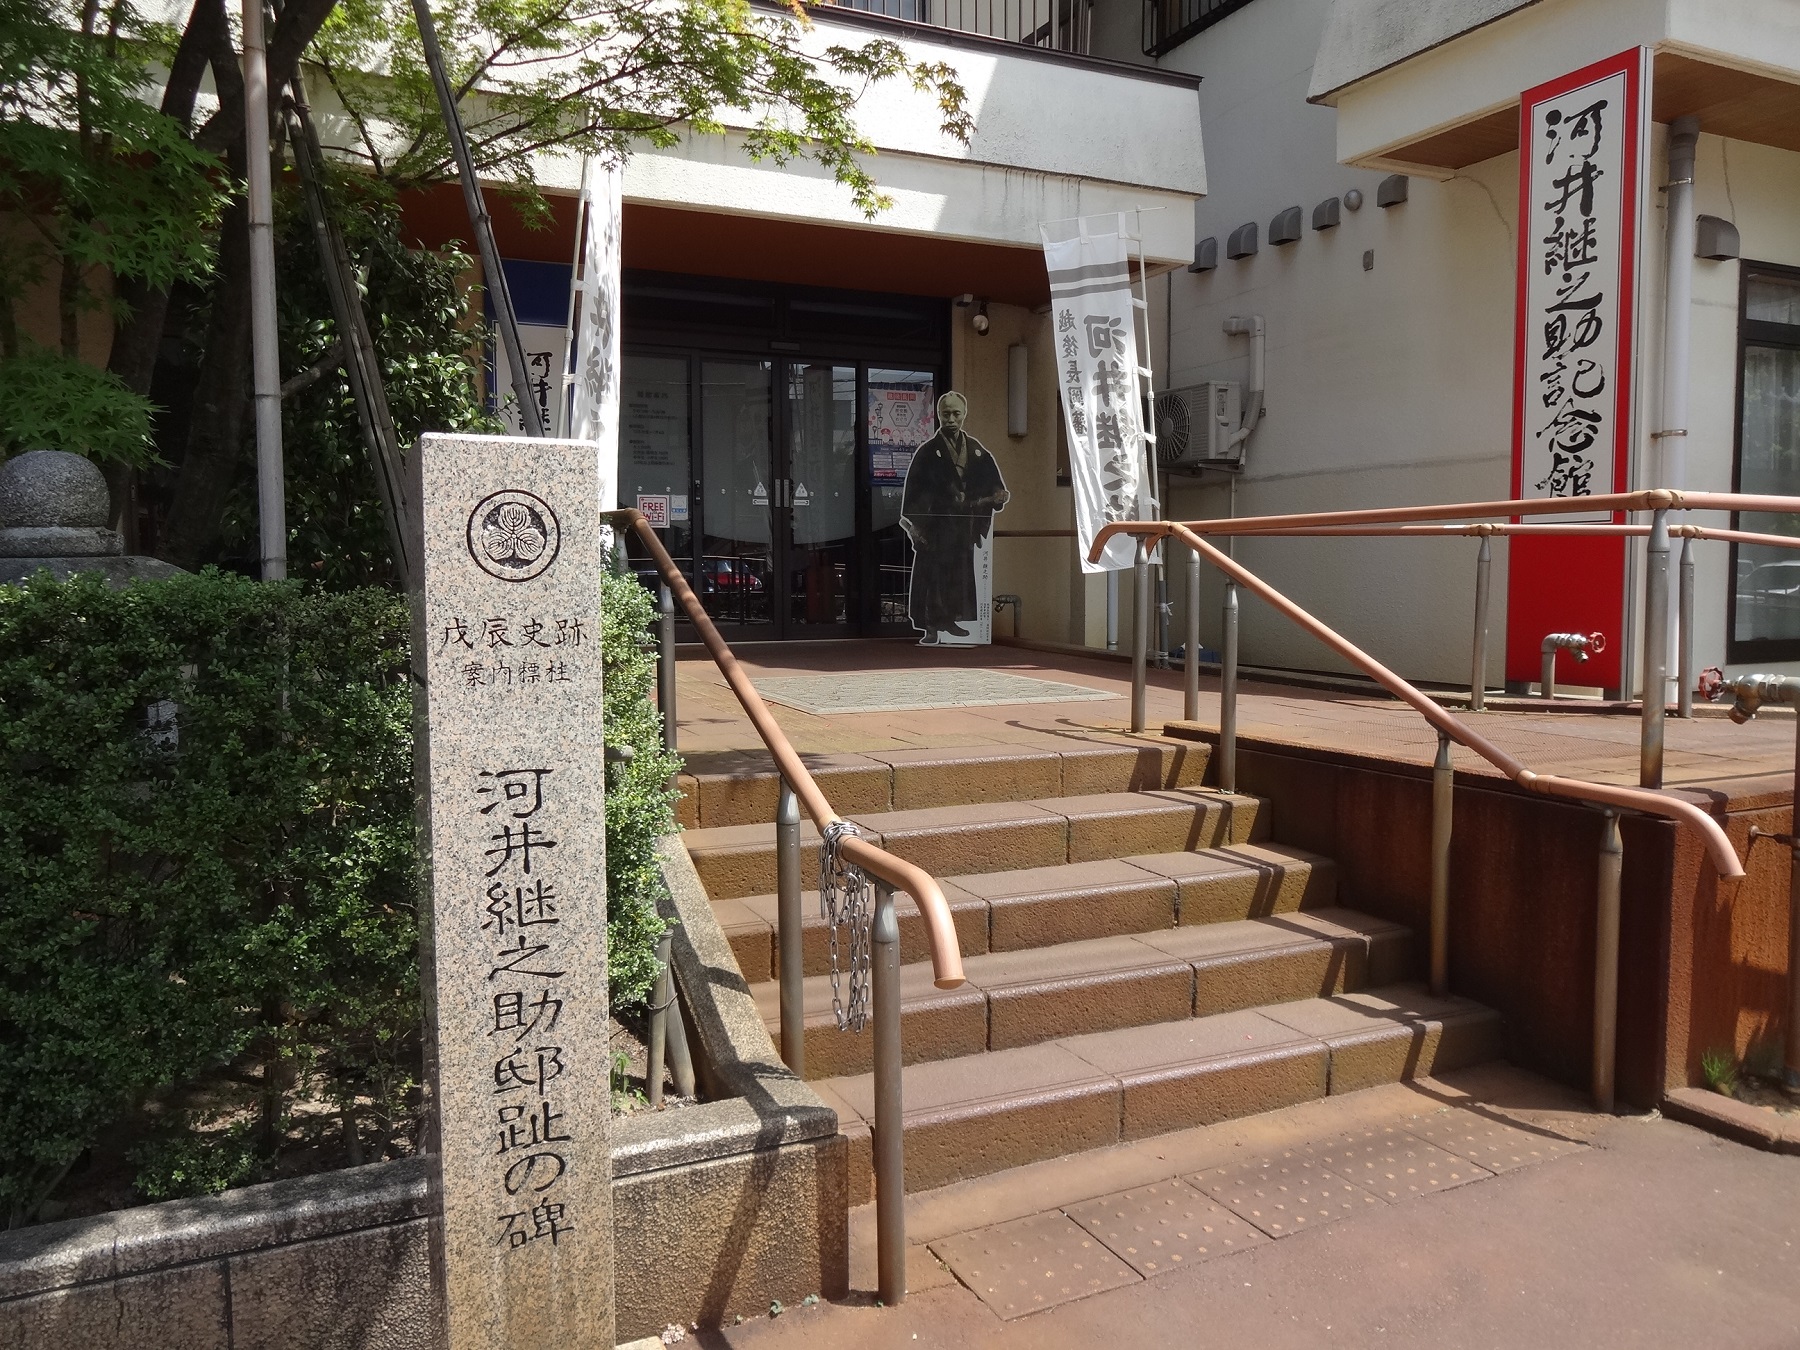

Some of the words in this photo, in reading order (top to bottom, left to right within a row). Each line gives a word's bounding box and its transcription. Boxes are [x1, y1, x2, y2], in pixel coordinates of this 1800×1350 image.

[1535, 99, 1608, 498] 河井継之助記念館
[642, 502, 664, 511] FREE
[643, 512, 665, 521] Wi-Fi
[441, 616, 589, 650] 戊辰史跡
[461, 659, 571, 687] 案内標柱
[476, 768, 575, 1249] 河井継之助邸趾の碑
